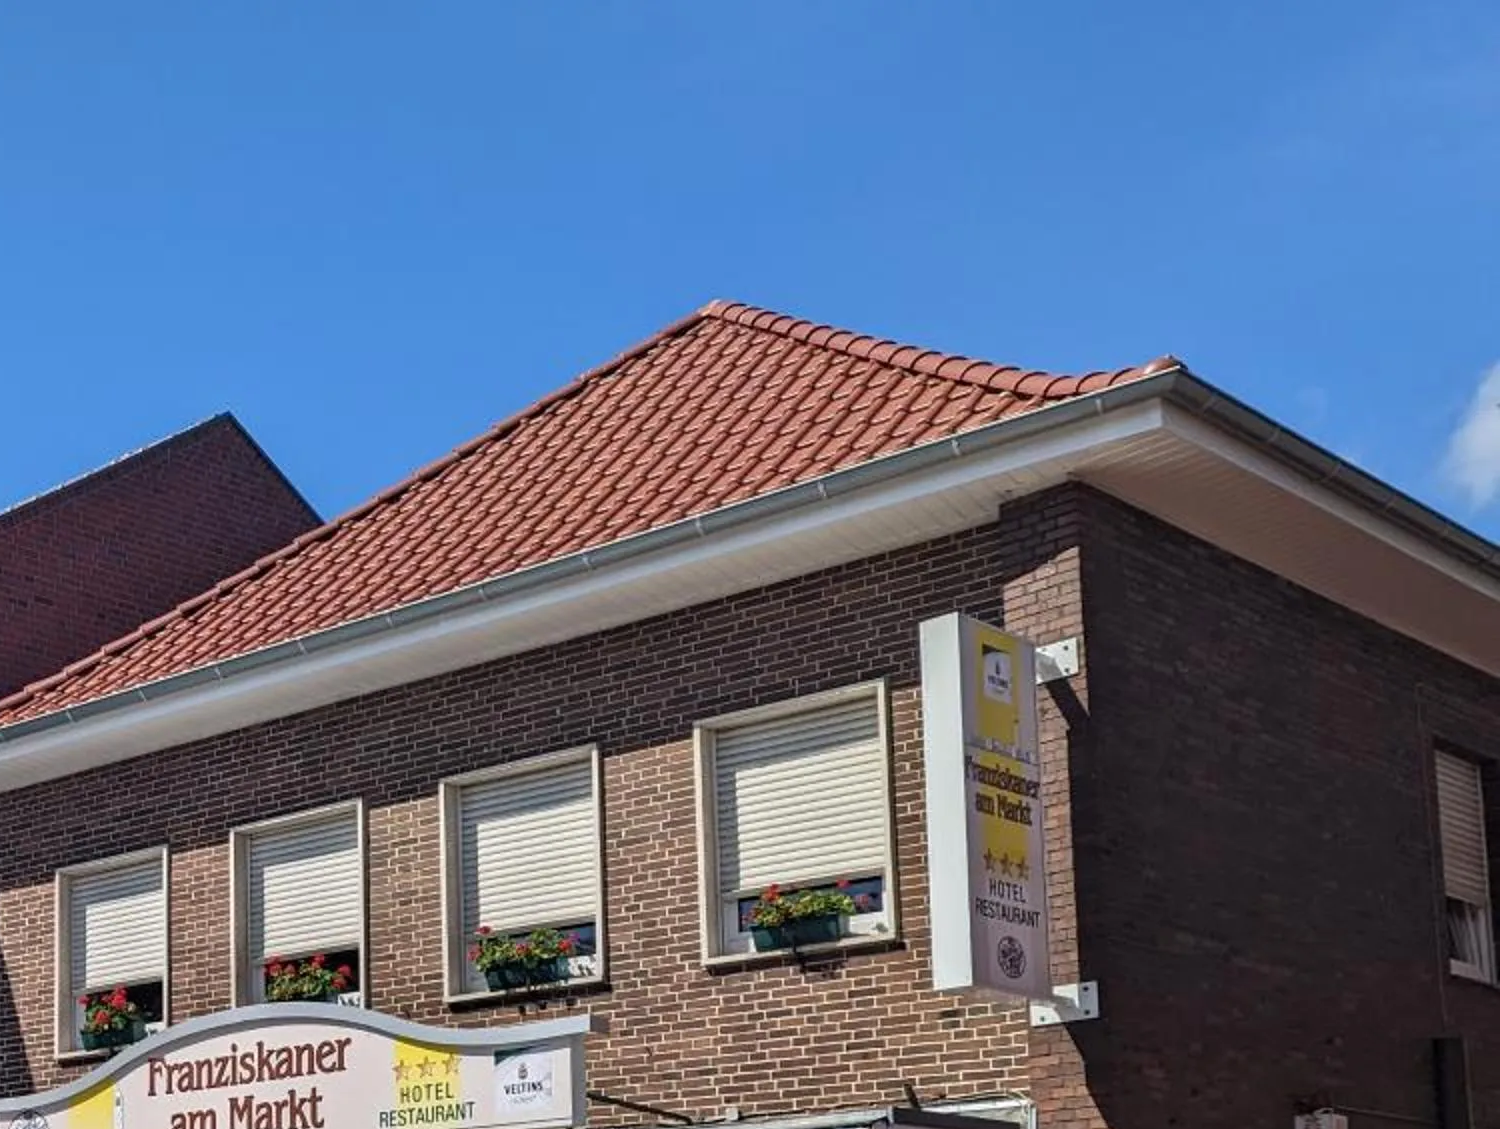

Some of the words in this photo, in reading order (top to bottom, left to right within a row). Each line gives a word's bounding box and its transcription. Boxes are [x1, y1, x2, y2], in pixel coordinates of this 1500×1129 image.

[976, 792, 995, 816] am
[996, 793, 1032, 826] Markt
[989, 878, 1026, 904] HOTEL
[975, 897, 1040, 929] RESTAURANT
[148, 1037, 352, 1096] Franziskaner
[400, 1082, 454, 1104] HOTEL
[504, 1081, 543, 1095] VELTINS
[379, 1102, 475, 1128] RESTAURANT
